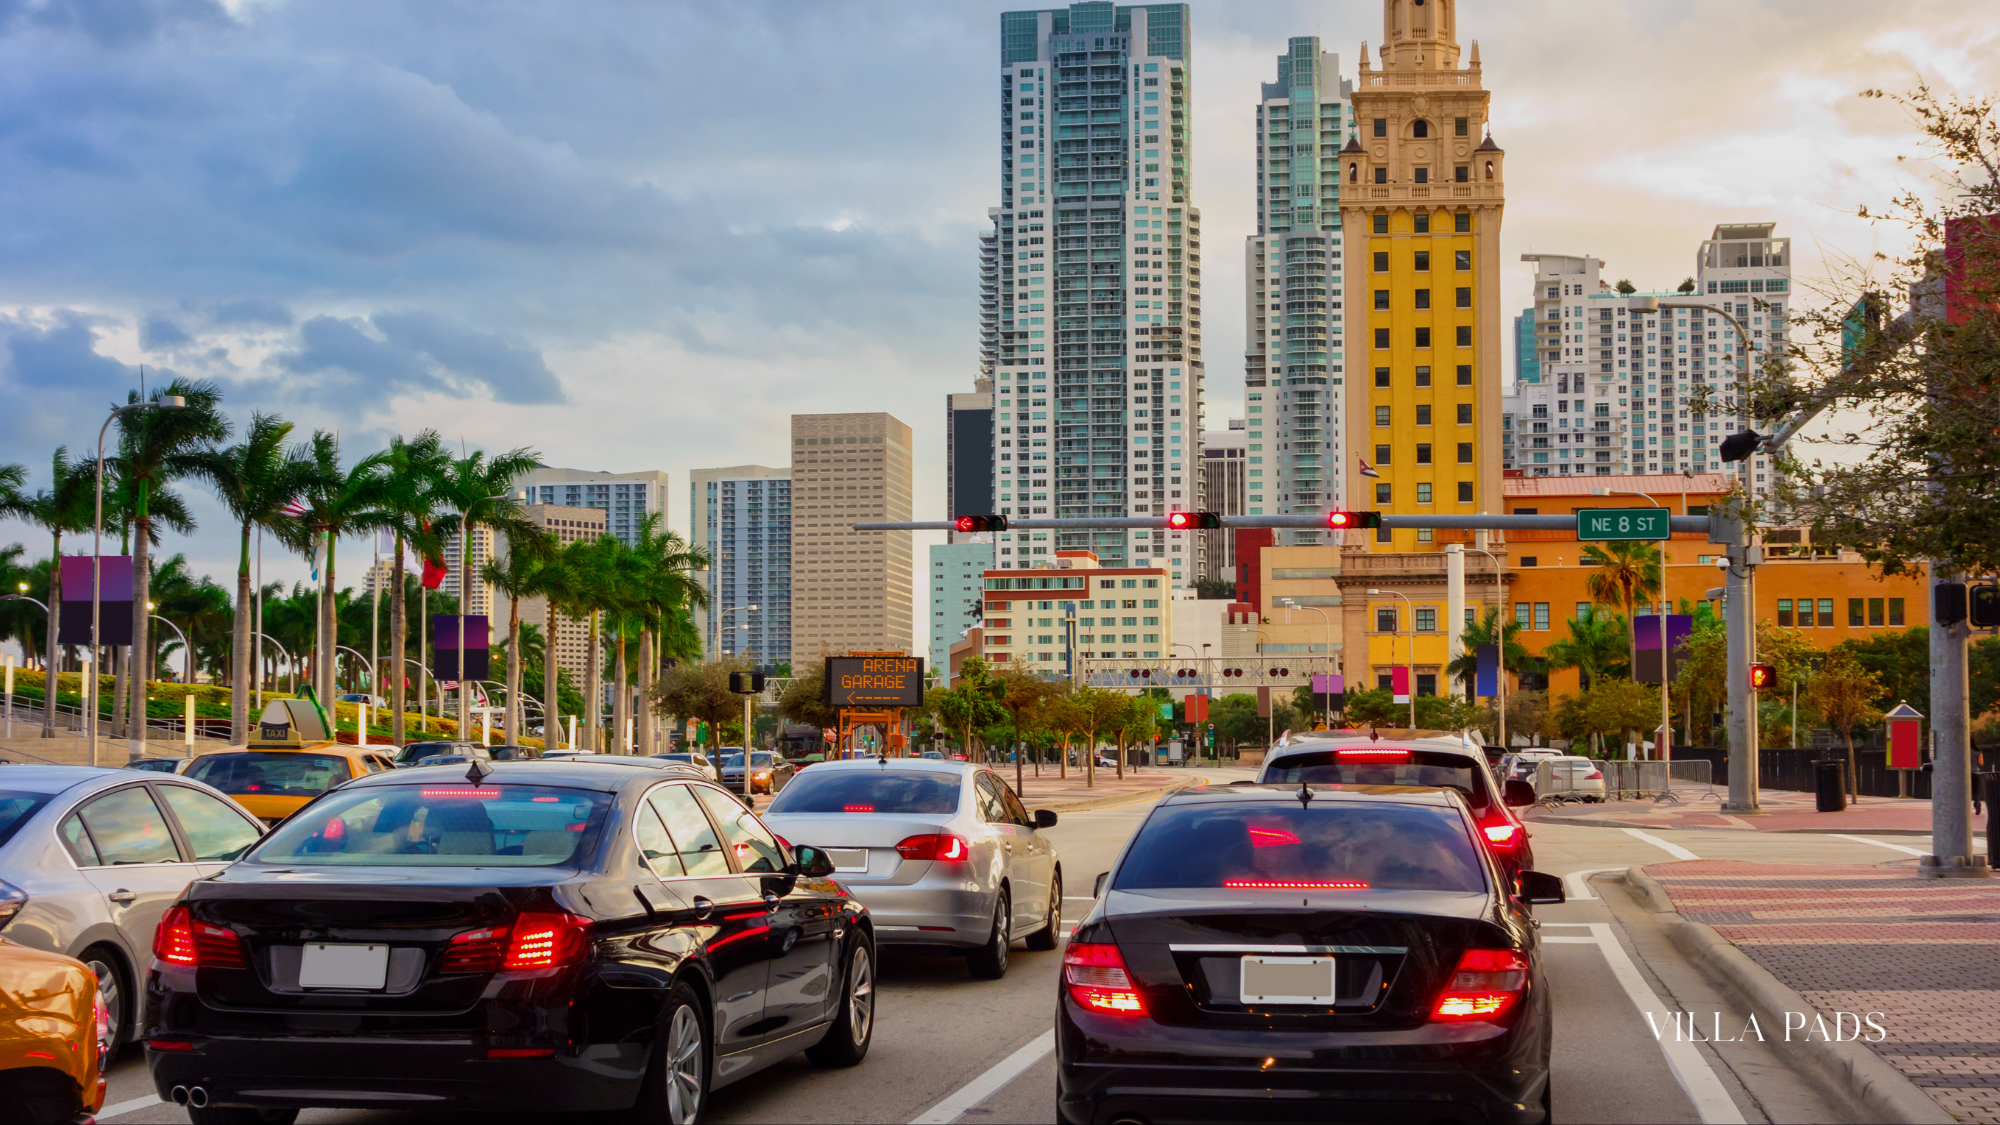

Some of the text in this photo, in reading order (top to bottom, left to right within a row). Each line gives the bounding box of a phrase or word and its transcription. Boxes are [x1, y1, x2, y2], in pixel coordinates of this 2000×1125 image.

[1591, 516, 1656, 533] NE 8 ST
[863, 658, 917, 673] ARENA
[841, 674, 906, 689] GARAGE
[265, 728, 286, 738] TAXI
